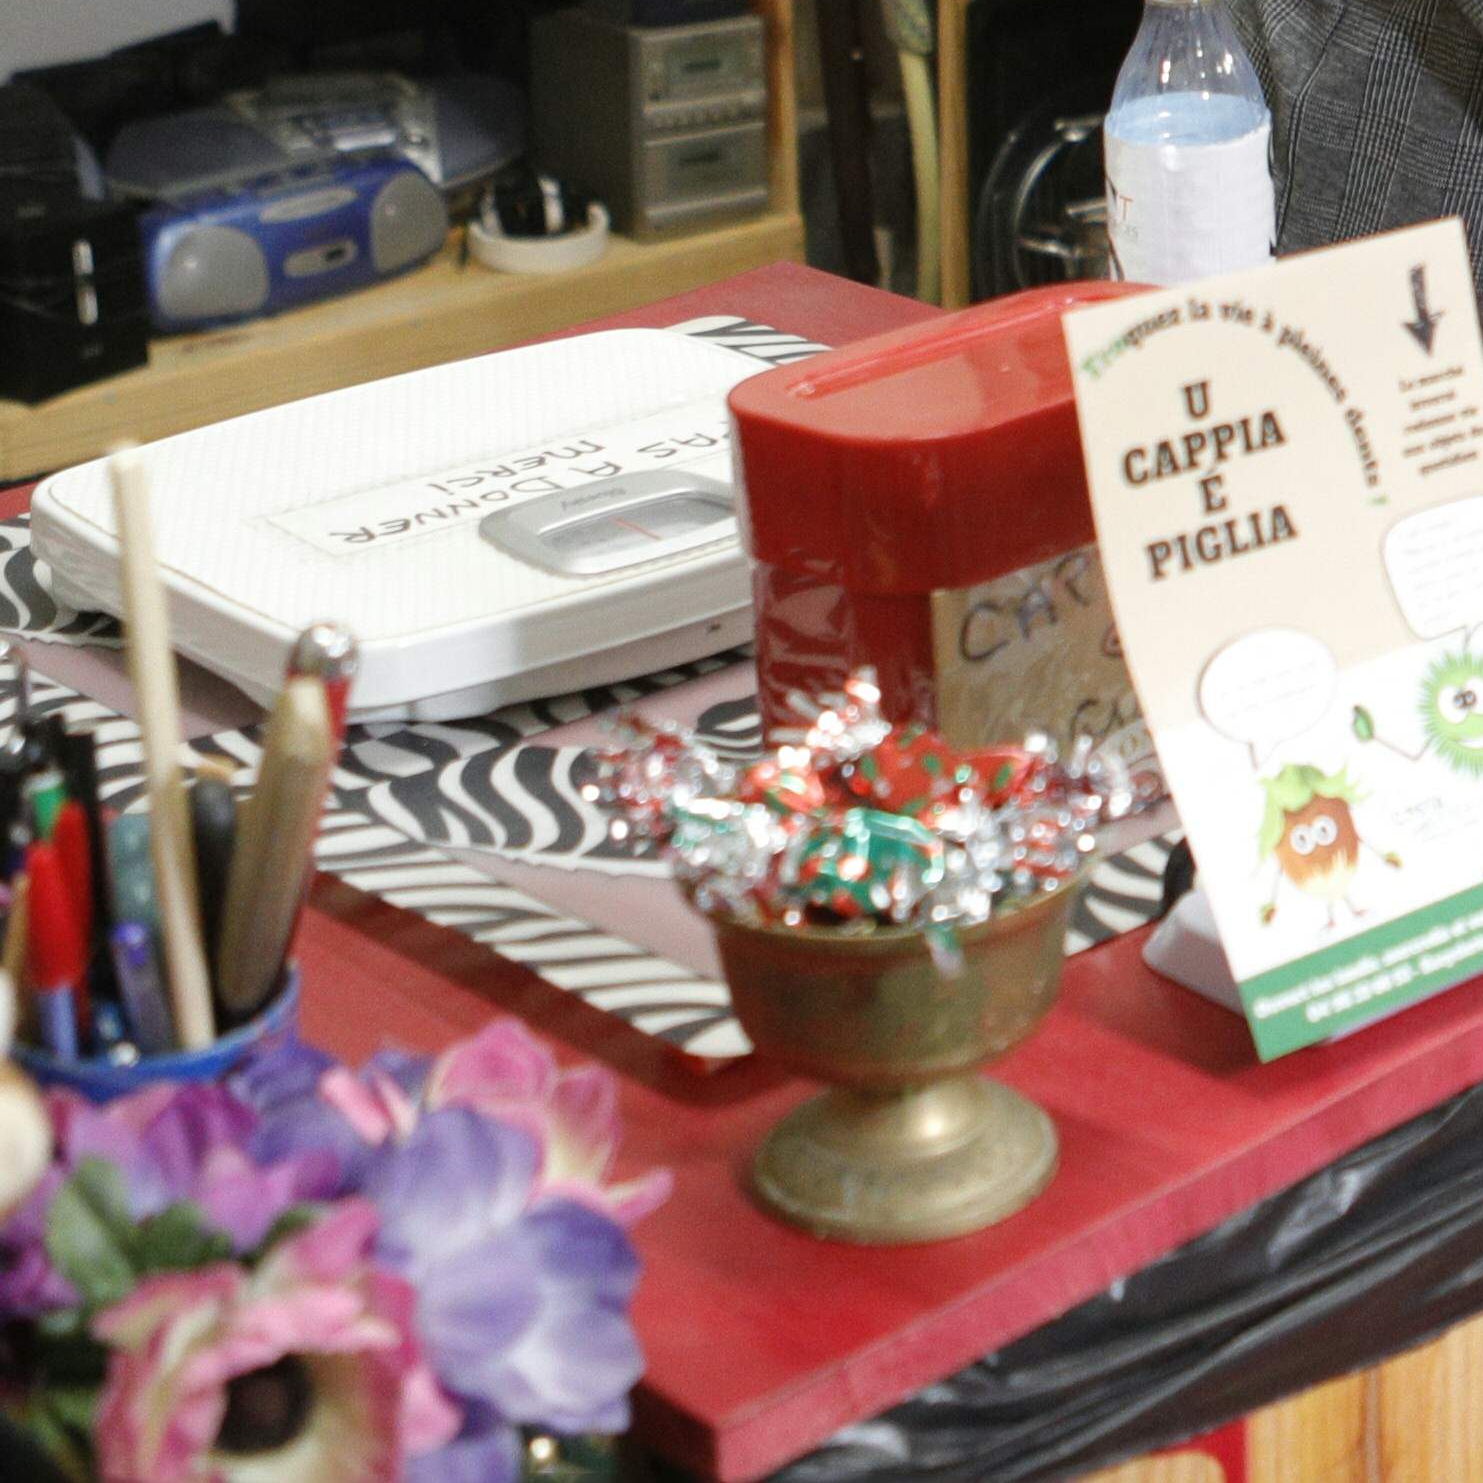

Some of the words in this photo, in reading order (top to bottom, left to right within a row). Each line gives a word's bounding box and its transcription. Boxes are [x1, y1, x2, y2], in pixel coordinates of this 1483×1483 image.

[1180, 379, 1211, 420] U
[637, 421, 731, 459] AS
[1121, 410, 1287, 488] CAPPIA
[329, 475, 565, 544] DONNER
[1145, 504, 1299, 582] PIGLIA
